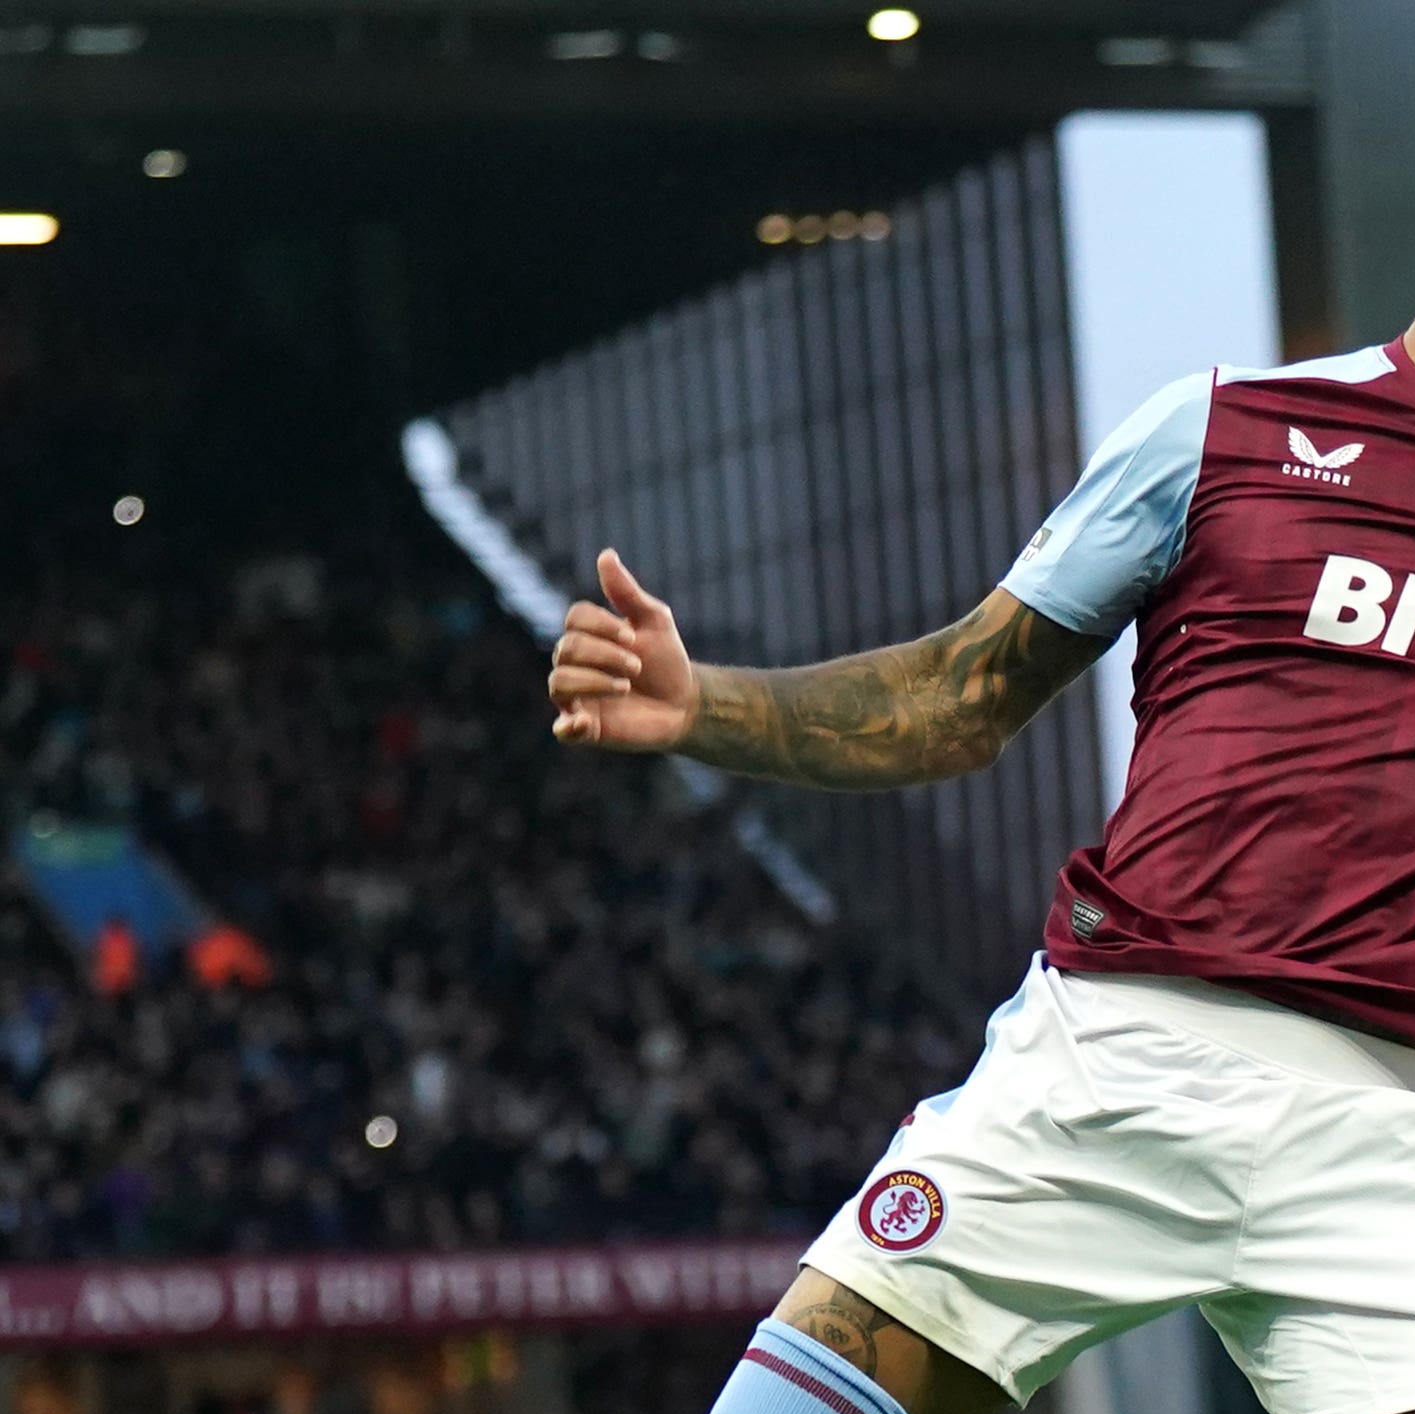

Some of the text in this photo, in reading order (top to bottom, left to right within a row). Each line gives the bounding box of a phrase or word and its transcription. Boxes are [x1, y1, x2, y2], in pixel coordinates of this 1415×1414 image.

[1282, 463, 1351, 487] CASTORE
[889, 1174, 940, 1219] ASTON VILLA
